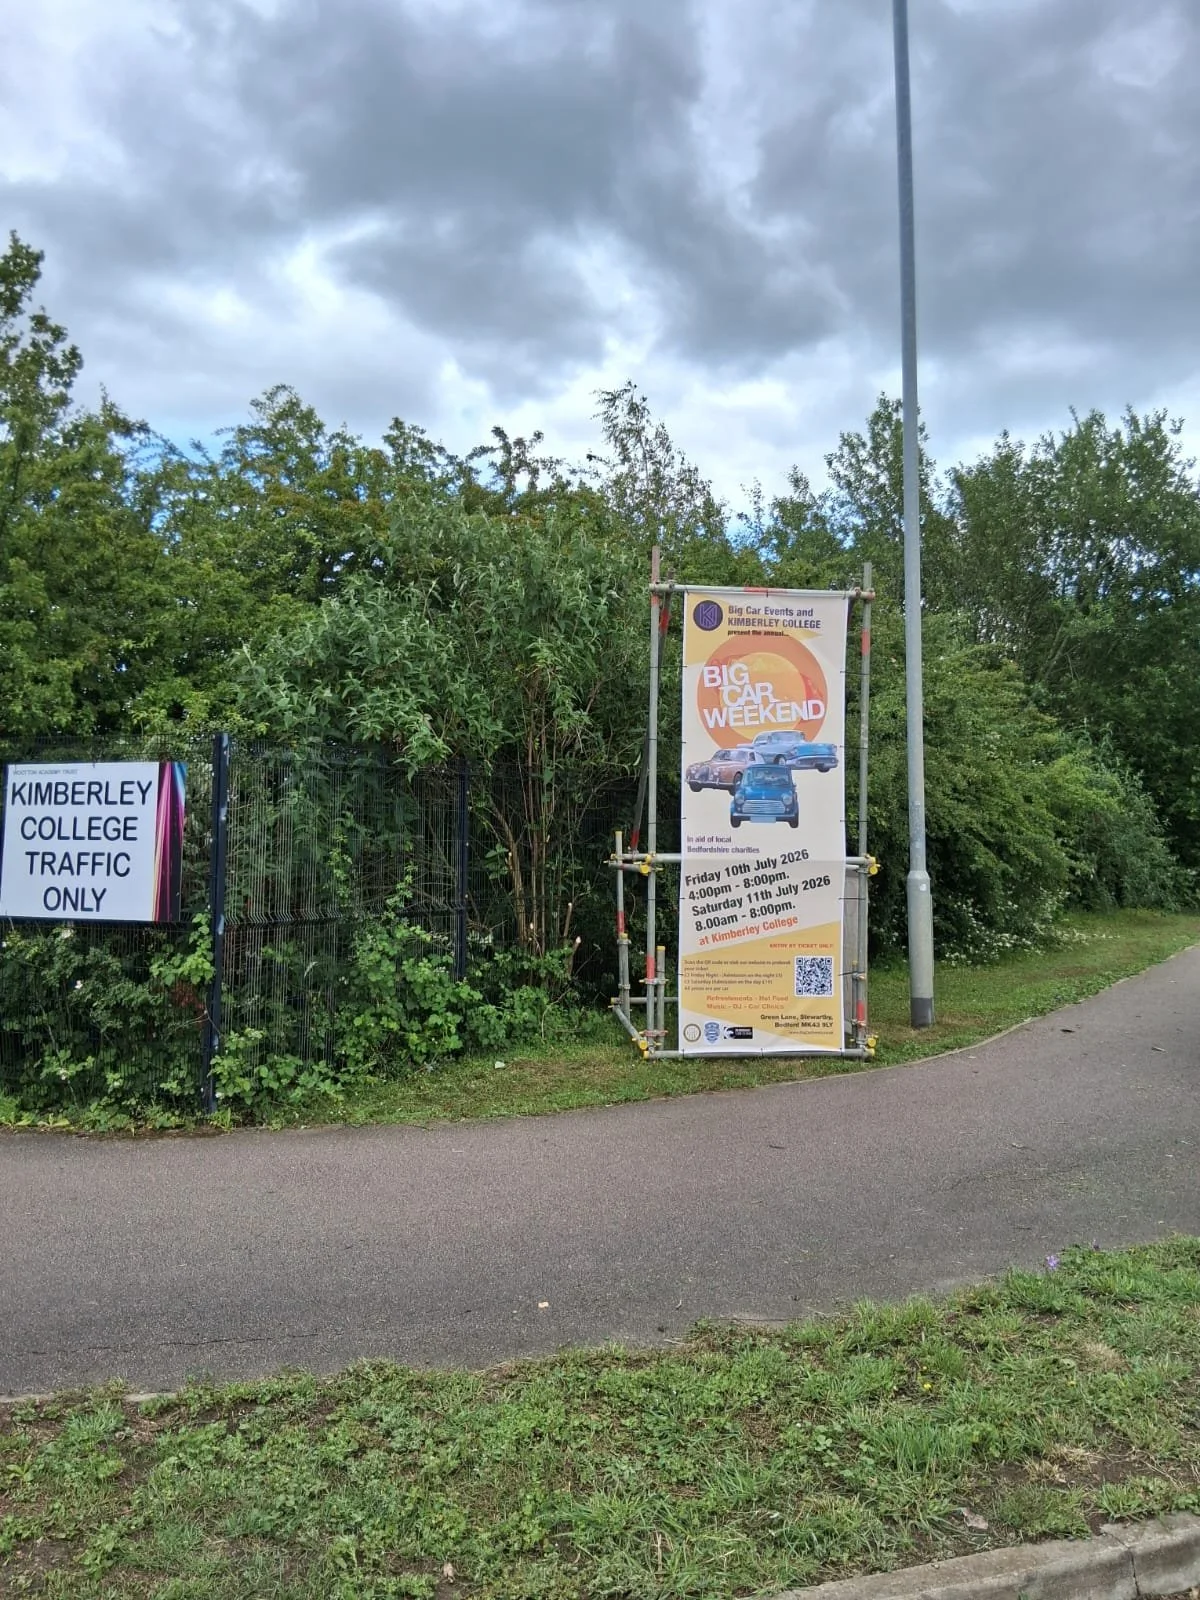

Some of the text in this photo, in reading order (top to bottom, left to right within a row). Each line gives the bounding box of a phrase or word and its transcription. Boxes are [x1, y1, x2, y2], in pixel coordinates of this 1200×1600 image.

[728, 606, 813, 616] Big Car Events and
[728, 618, 821, 628] KIMBERLEY COLLEGE
[703, 662, 750, 688] BIG
[719, 682, 782, 707] CAR
[703, 700, 825, 728] WEEKEND
[12, 780, 152, 806] KIMBERLEY
[20, 816, 138, 841] COLLEGE
[25, 852, 130, 877] TRAFFIC
[685, 849, 809, 886] Friday 10th July 2026
[688, 883, 732, 901] 4:00pm
[743, 870, 790, 889] 8:00pm.
[692, 875, 831, 916] Saturday 11th July 2026
[44, 886, 107, 912] ONLY
[695, 914, 738, 932] 8.00am
[750, 901, 796, 919] 8:00pm.
[699, 916, 798, 946] at Kimberley College
